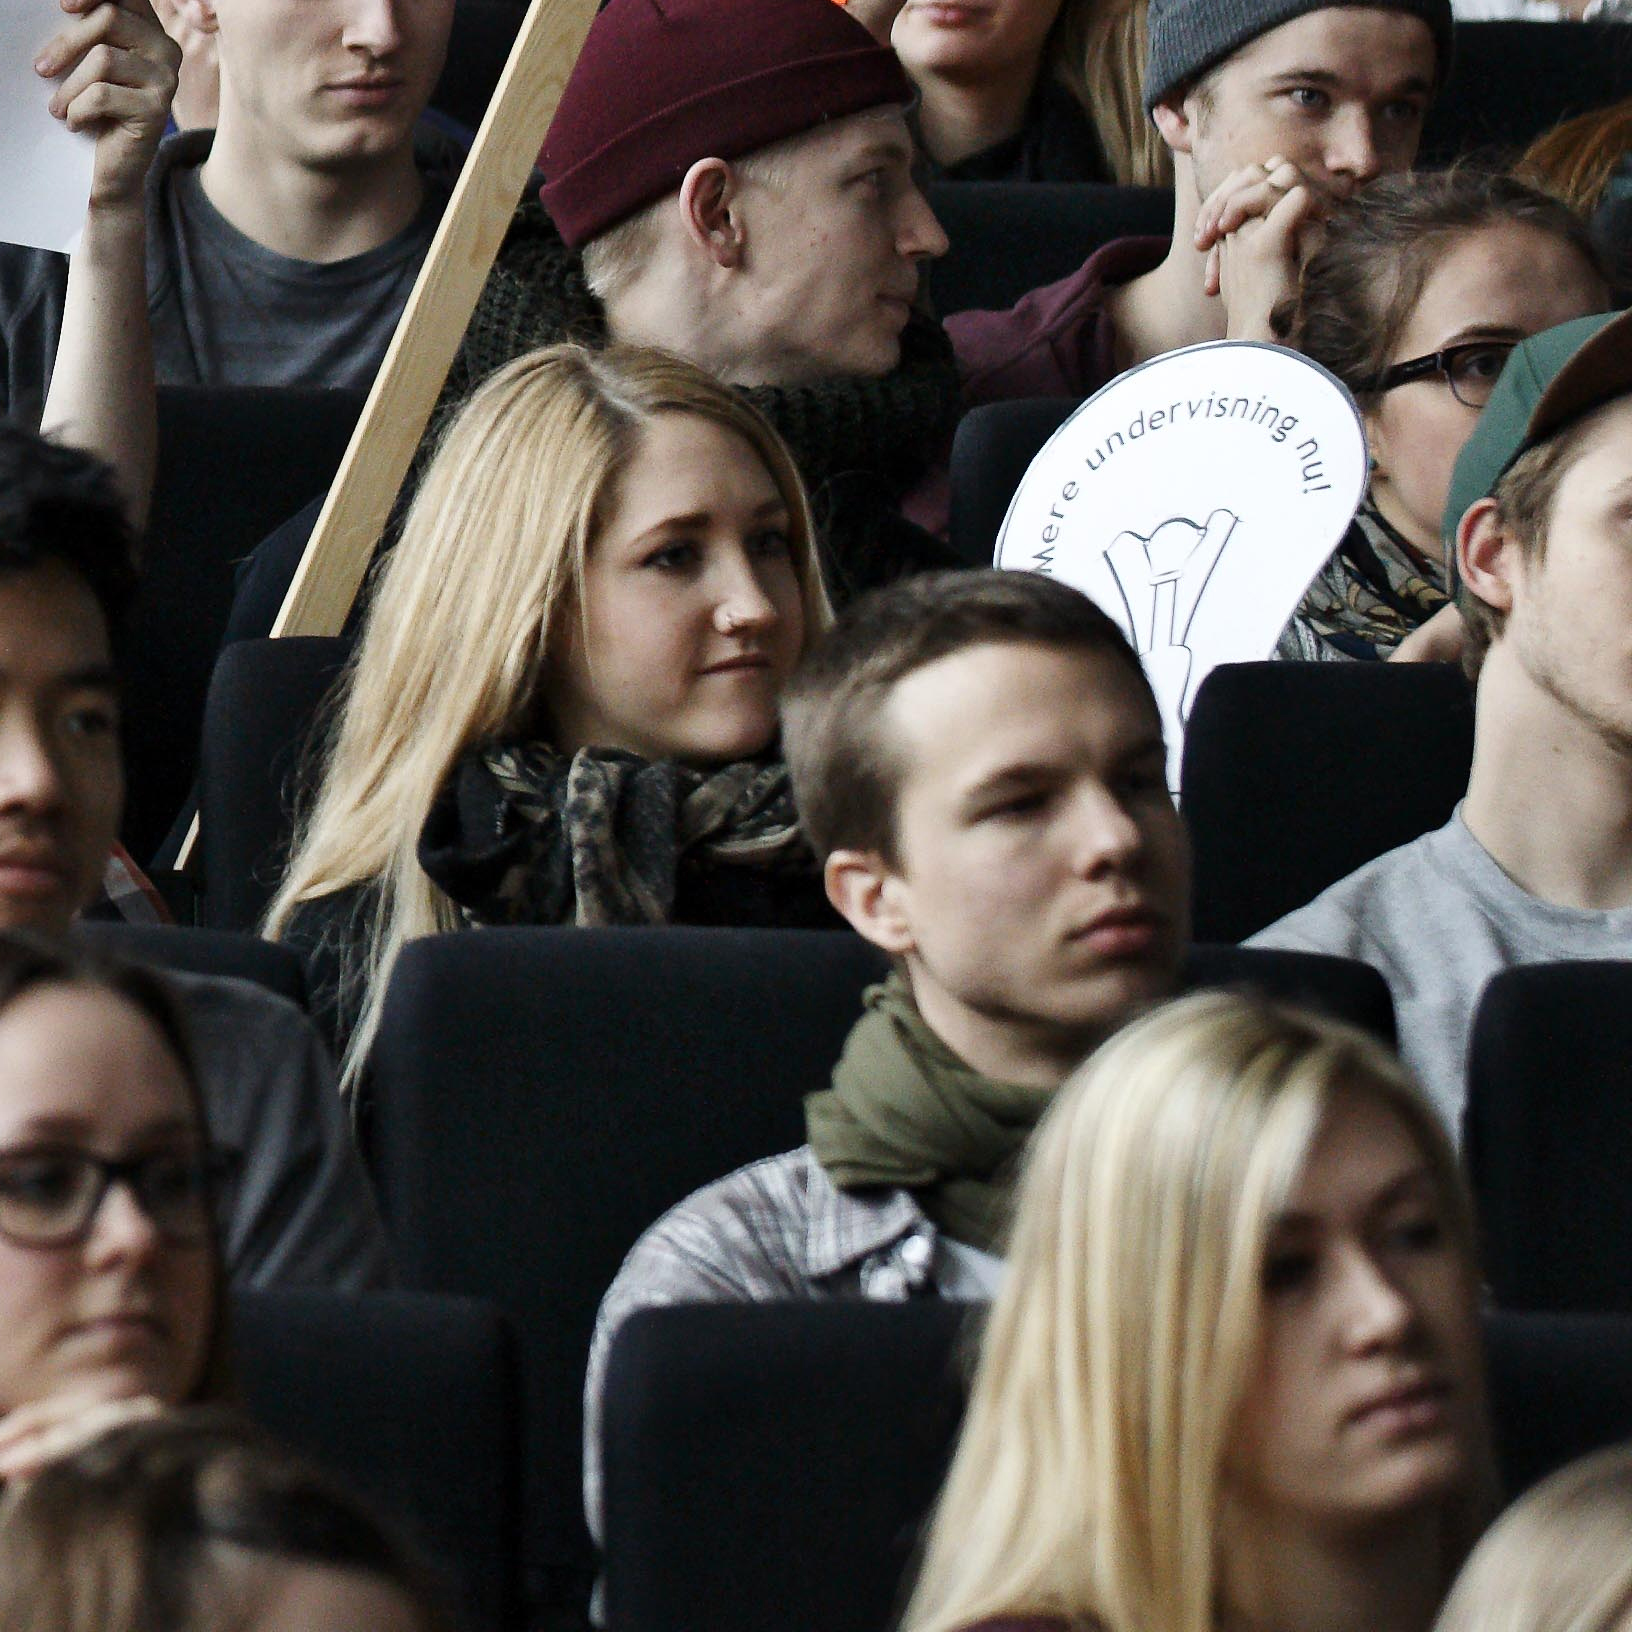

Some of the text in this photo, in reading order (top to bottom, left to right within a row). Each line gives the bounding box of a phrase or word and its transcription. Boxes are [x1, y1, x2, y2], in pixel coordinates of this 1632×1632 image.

[1032, 390, 1332, 573] Mere undervisning nu!
